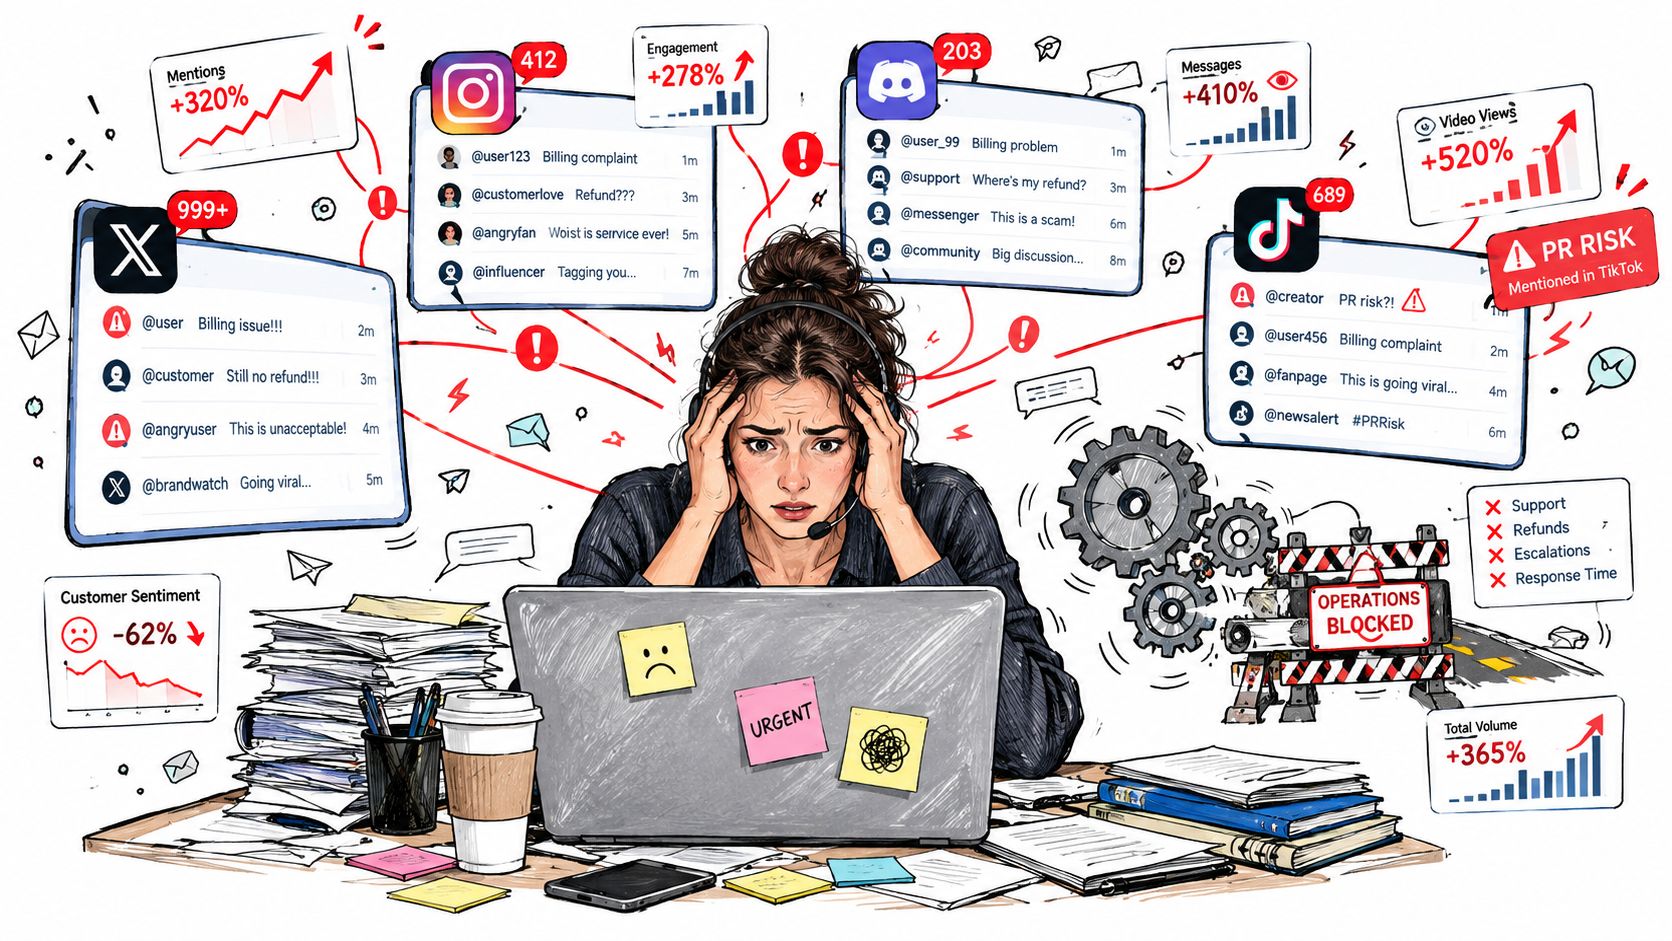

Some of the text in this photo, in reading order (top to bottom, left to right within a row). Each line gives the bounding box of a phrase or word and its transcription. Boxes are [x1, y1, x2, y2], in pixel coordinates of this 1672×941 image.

[648, 41, 718, 57] Engagement
[944, 42, 981, 60] 203
[521, 50, 556, 69] 412
[1181, 58, 1242, 74] Messages
[167, 64, 226, 84] Mentions
[648, 63, 724, 87] +278%
[170, 84, 249, 114] +320%
[1183, 81, 1258, 105] +410%
[1439, 106, 1518, 129] Video Views
[901, 135, 1126, 156] @user_99 Billing problem 1m
[1421, 136, 1514, 172] +520%
[472, 151, 697, 166] @user123 Billing complaint 1m
[901, 171, 1126, 193] @support Where's my refund? 3m
[472, 188, 698, 202] @customerlove Refund??? 3m
[1314, 186, 1345, 203] 689
[178, 201, 228, 219] 999+
[901, 207, 1126, 229] @messenger This is a scam! 6m
[473, 226, 536, 241] @angryfan
[584, 227, 592, 238] is
[642, 229, 668, 239] ever!
[683, 229, 698, 240] 5m
[1542, 226, 1636, 262] PR RISK
[901, 244, 1126, 265] @community Big discussion... 8m
[473, 265, 698, 280] @influencer Tagging you... 7m
[1508, 260, 1643, 296] Mentioned in TikTok
[1266, 290, 1324, 304] @creator
[1340, 294, 1356, 306] PR
[1361, 295, 1394, 308] risk?!
[143, 315, 374, 336] @user Billing issue!!! 2m
[1265, 329, 1508, 357] @user456 Billing complaint 2m
[143, 368, 376, 385] @customer Still no refund!!! 3m
[1265, 368, 1507, 397] @fanpage This is going viral... 4m
[143, 422, 379, 439] @angryuser This is unacceptable! 4m
[1265, 409, 1506, 438] @newsalert #PRRisk 6m
[143, 474, 382, 495] @brandwatch Going viral... 5m
[1512, 498, 1566, 514] Support
[1514, 521, 1569, 536] Refunds
[1515, 545, 1590, 560] Escalations
[1515, 568, 1617, 586] Response Time
[61, 589, 200, 604] Customer Sentiment
[1317, 591, 1421, 610] OPERATIONS
[114, 622, 177, 645] -62%
[1327, 613, 1414, 636] BLOCKED
[750, 702, 812, 738] URGENT
[1444, 720, 1517, 735] Total Volume
[1446, 741, 1526, 766] +365%
